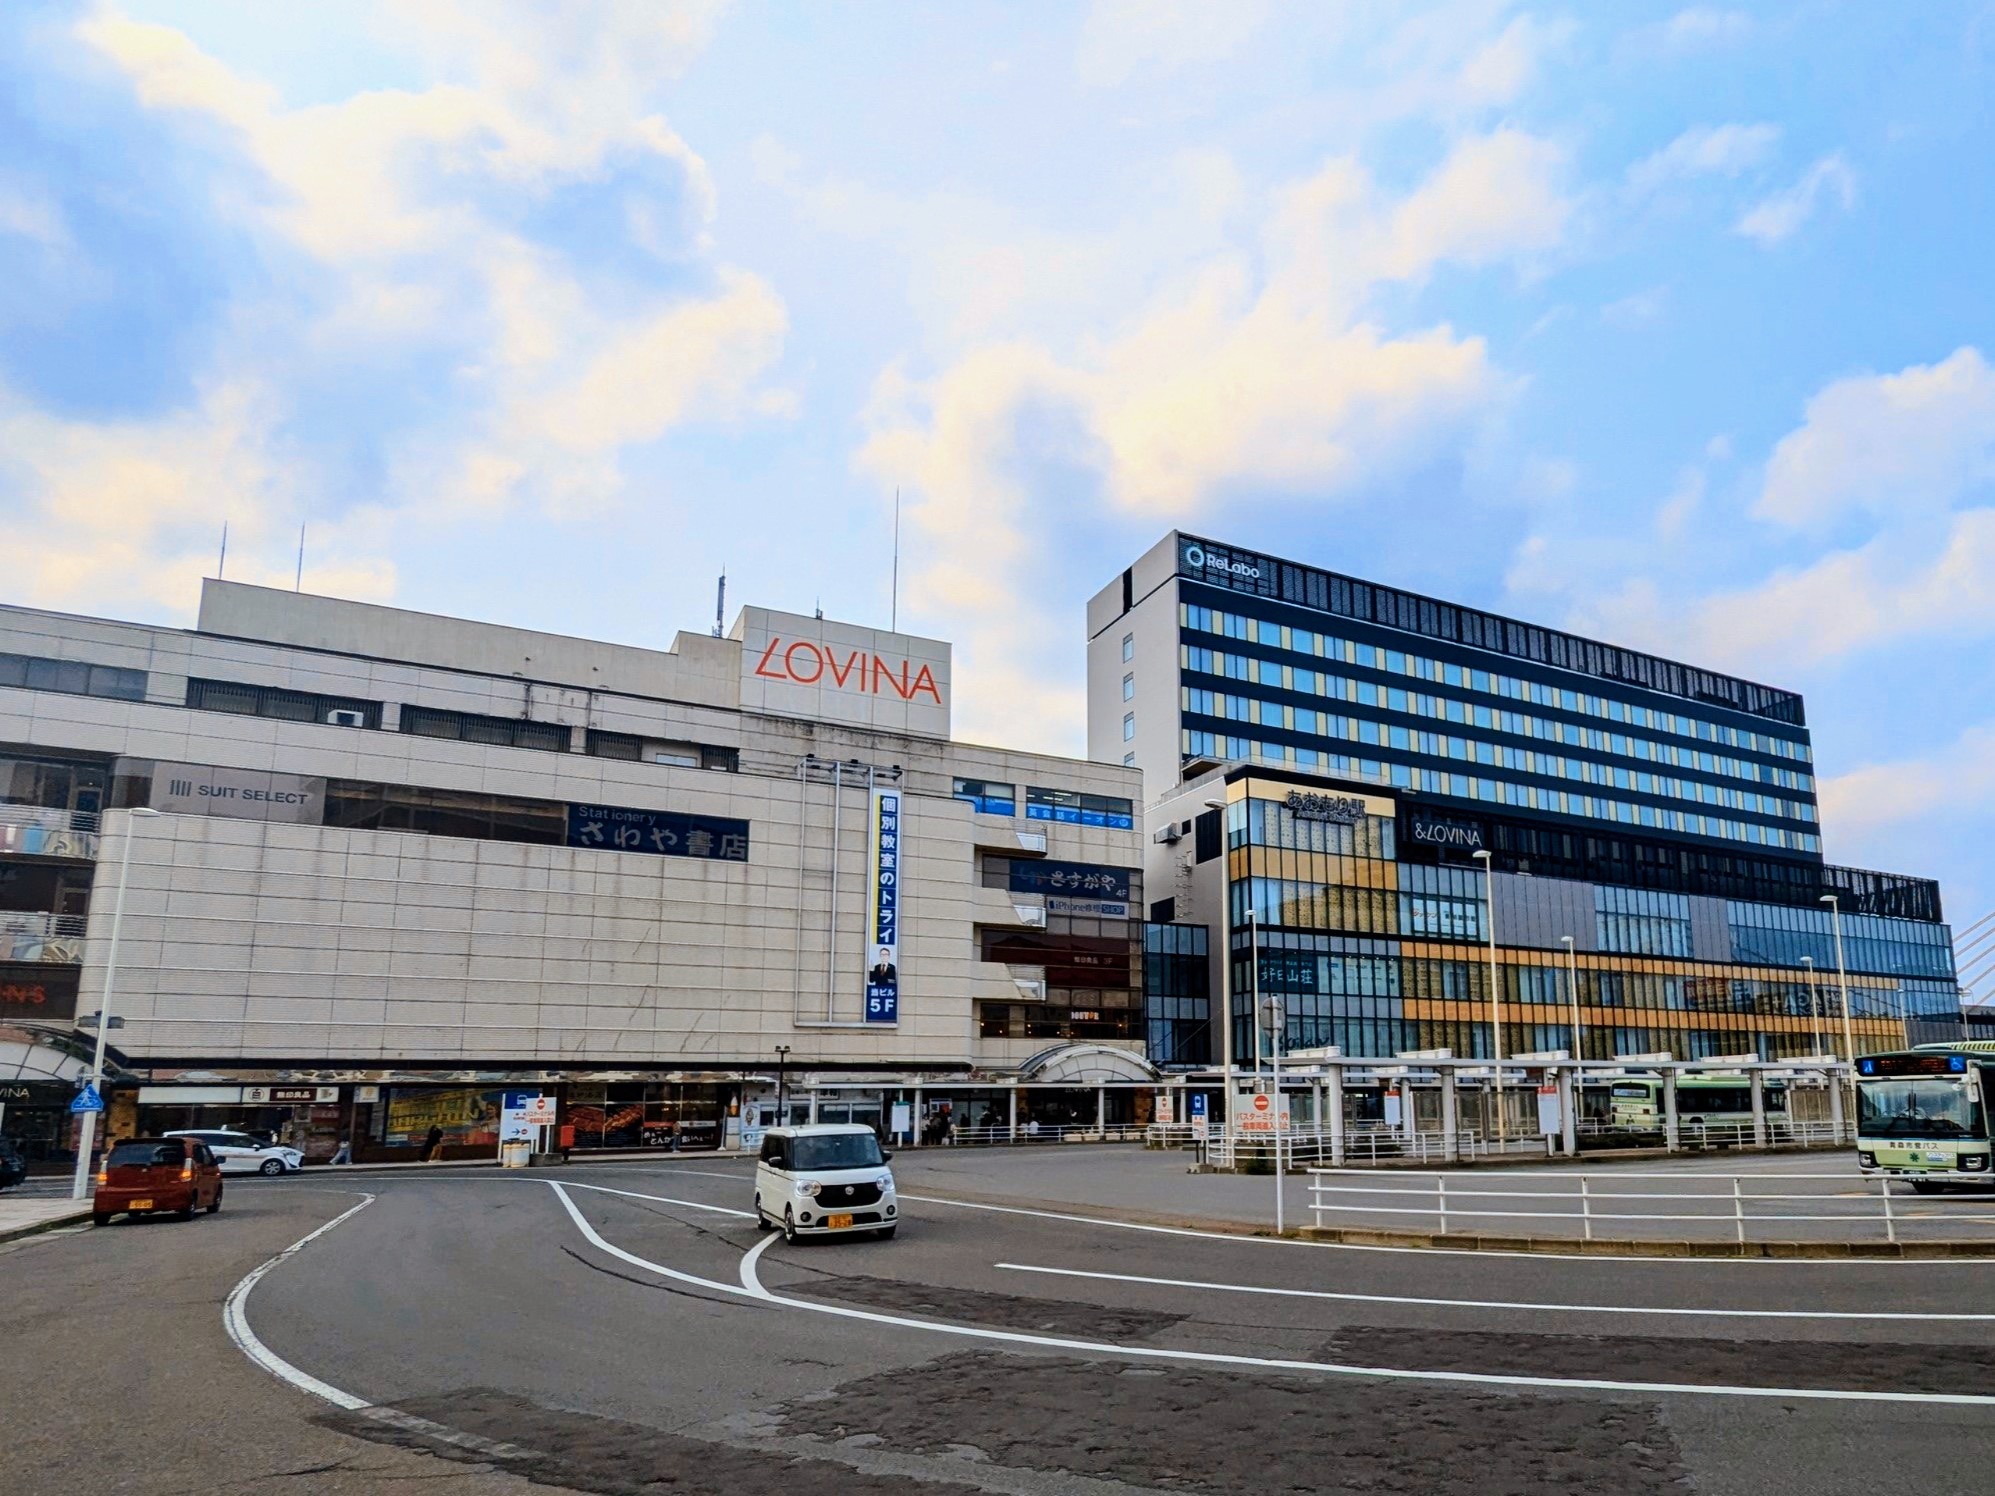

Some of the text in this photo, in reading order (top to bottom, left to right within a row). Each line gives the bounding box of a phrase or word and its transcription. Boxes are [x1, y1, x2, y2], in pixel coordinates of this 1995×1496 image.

[1206, 554, 1260, 578] ReLabo
[755, 637, 941, 704] LOVINA
[198, 784, 308, 804] SUIT SELECT
[1028, 807, 1117, 825] 英会話イーオン
[579, 821, 747, 859] さわや書店
[1415, 822, 1482, 847] &LOVINA
[879, 797, 897, 943] 個別教室のトライ
[1115, 889, 1127, 898] 4F
[1102, 904, 1124, 915] SHOP
[870, 988, 895, 997] 当ビル
[870, 998, 895, 1013] 5F
[1236, 1112, 1289, 1120] バスターミナ内
[1889, 1141, 1939, 1150] 青森市営バス
